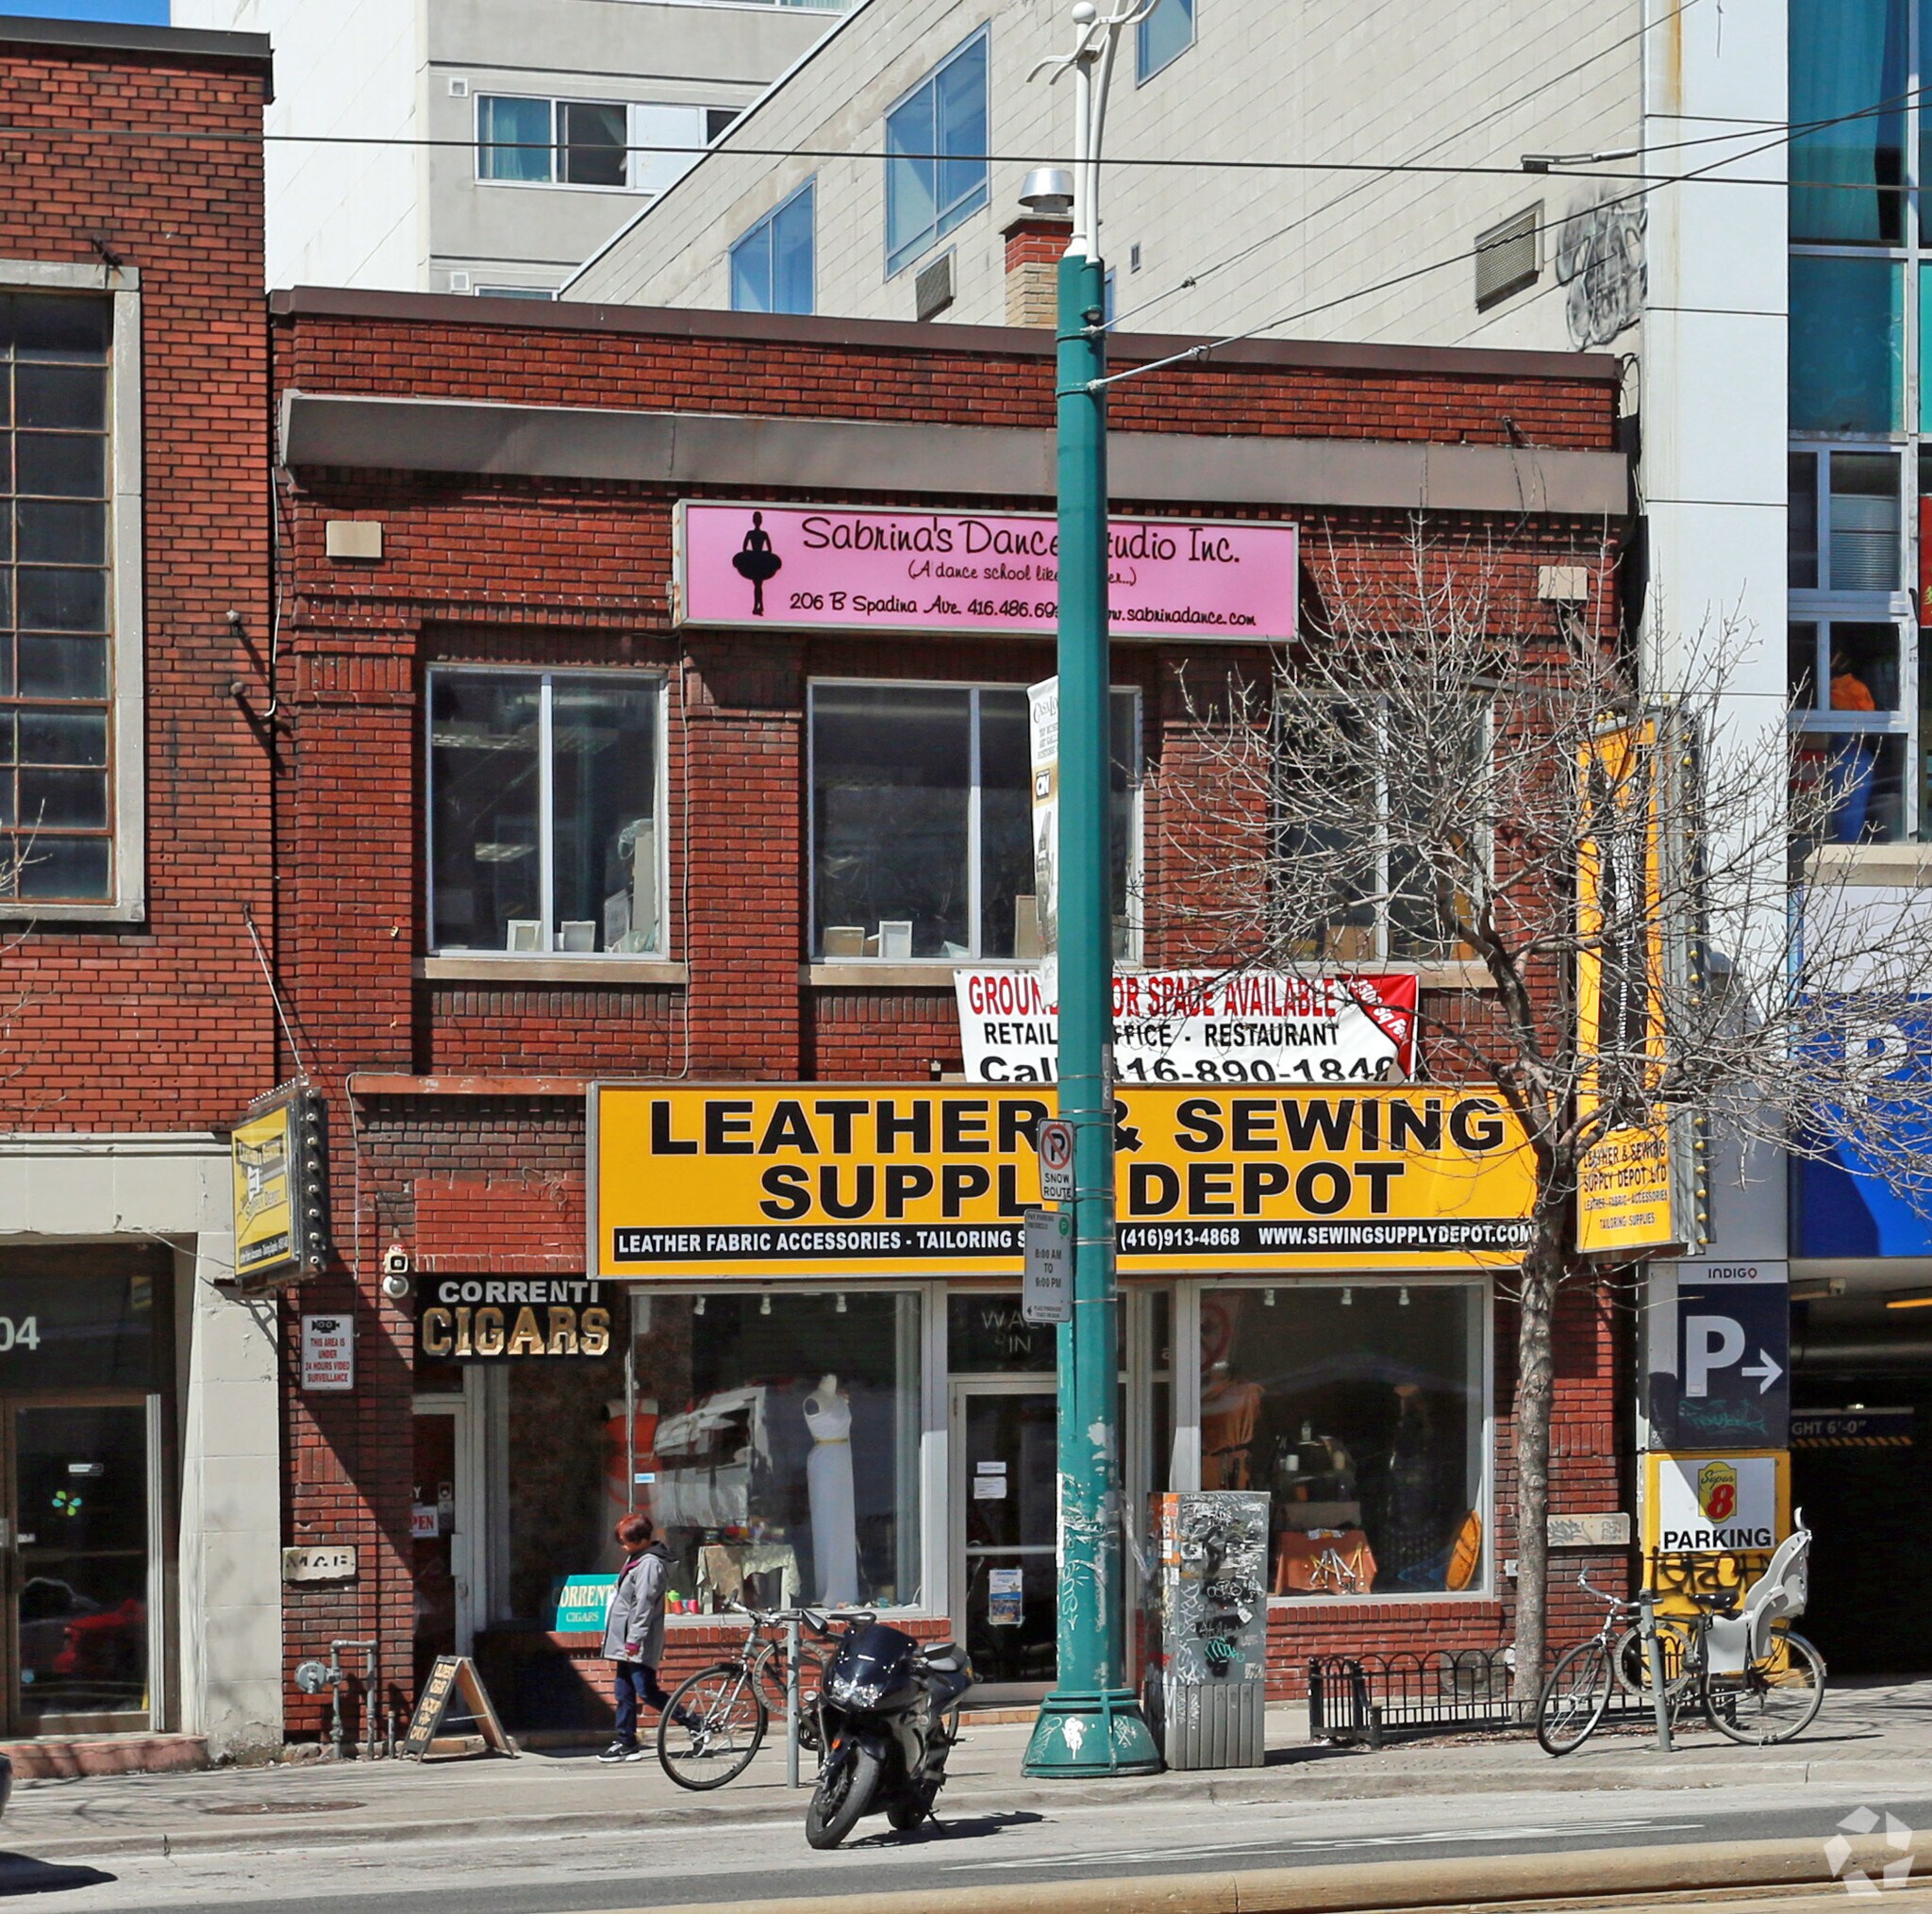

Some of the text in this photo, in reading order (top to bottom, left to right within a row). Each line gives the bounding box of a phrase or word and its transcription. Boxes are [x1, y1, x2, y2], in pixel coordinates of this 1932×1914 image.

[802, 516, 1241, 562] Sabrina's Dance tudio Inc.
[908, 559, 930, 579] (A
[936, 561, 978, 579] dance
[984, 563, 1031, 581] school
[790, 592, 824, 610] 206
[829, 591, 847, 610] B
[853, 595, 918, 615] Spadina
[924, 595, 962, 614] Ave.
[968, 975, 1337, 1017] GROUN OR SPACE AVAILABLE
[983, 1023, 1058, 1044] RETAIL
[1205, 1024, 1339, 1047] RESTAURANT
[980, 1056, 1058, 1082] Cal
[651, 1097, 1505, 1155] LEATHER & SEWING
[1044, 1173, 1070, 1184] SNOW
[1584, 1172, 1613, 1193] SUPPLY
[1618, 1167, 1646, 1188] DEPOT
[759, 1162, 1405, 1219] SUPPL DEPOT
[1043, 1186, 1072, 1198] ROUTE
[1629, 1212, 1656, 1225] SUPPLIES
[619, 1234, 701, 1252] LEATHER
[707, 1233, 772, 1251] FABRIC
[776, 1232, 901, 1250] ACCESSORIES
[917, 1230, 1012, 1249] TAILORING
[1121, 1227, 1241, 1251] (416)913-4868
[1258, 1224, 1532, 1245] WWW.SEWINGSUPPLYDEPOT.COM
[1051, 1250, 1062, 1259] AM
[1044, 1263, 1054, 1273] TO
[439, 1281, 599, 1303] CORRENTI
[1051, 1277, 1061, 1288] PM
[982, 1309, 1047, 1330] WAL
[325, 1338, 338, 1347] AREA
[423, 1307, 610, 1356] CIGARS
[1009, 1336, 1031, 1353] IN
[1686, 1316, 1746, 1398] P
[1792, 1421, 1823, 1435] GHT
[1701, 1470, 1736, 1490] Super
[1707, 1484, 1736, 1519] 8
[411, 1514, 434, 1530] PEN
[1663, 1527, 1773, 1550] PARKING
